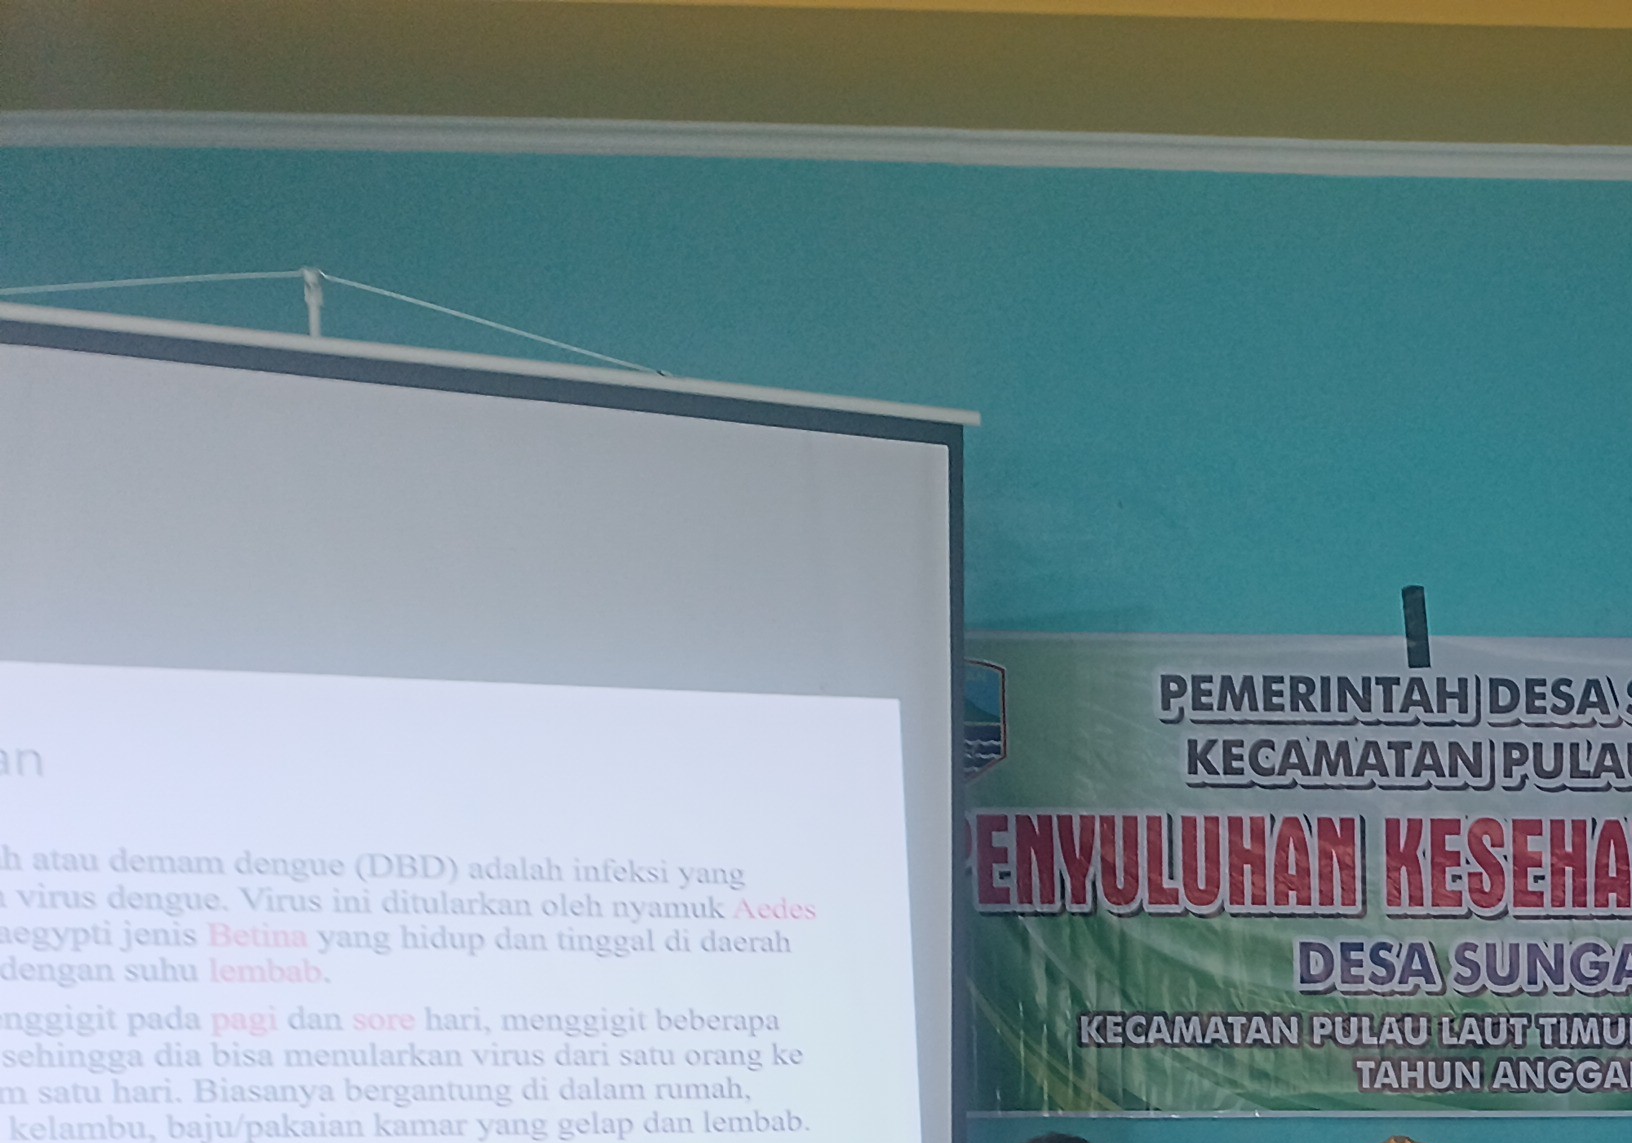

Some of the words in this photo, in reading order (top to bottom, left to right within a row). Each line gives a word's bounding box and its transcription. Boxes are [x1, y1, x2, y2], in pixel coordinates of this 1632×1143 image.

[1160, 674, 1475, 715] PEMERINTAH
[1487, 676, 1605, 716] DESA
[1186, 739, 1482, 779] KECAMATAN
[32, 849, 100, 873] atau
[108, 846, 226, 876] demam
[233, 849, 346, 884] dengue
[354, 853, 459, 884] (DBD)
[468, 855, 565, 882] adalah
[573, 858, 670, 885] infeksi
[677, 866, 746, 892] yang
[15, 882, 98, 911] virus
[106, 883, 229, 918] dengue.
[238, 886, 324, 914] Virus
[332, 887, 373, 915] ini
[380, 888, 533, 917] ditularkan
[540, 892, 604, 918] oleh
[612, 895, 726, 925] nyamuk
[732, 896, 817, 921] Aedes
[0, 919, 114, 953] aegypti
[119, 919, 198, 954] jenis
[206, 921, 309, 949] Betina
[316, 929, 392, 956] yang
[399, 924, 486, 958] hidup
[493, 925, 549, 952] dan
[556, 926, 656, 959] tinggal
[664, 928, 692, 953] di
[700, 929, 792, 954] daerah
[0, 954, 116, 990] dengan
[123, 956, 199, 983] suhu
[208, 956, 332, 984] lembab.
[1299, 940, 1438, 986] DESA
[0, 1004, 118, 1038] nggigit
[126, 1005, 203, 1038] pada
[210, 1004, 279, 1038] pagi
[286, 1004, 345, 1032] dan
[352, 1012, 416, 1032] sore
[424, 1005, 492, 1036] hari,
[501, 1007, 647, 1039] menggigit
[655, 1007, 781, 1038] beberapa
[1079, 1014, 1299, 1047] KECAMATAN
[1311, 1014, 1428, 1047] PULAU
[1440, 1015, 1530, 1047] LAUT
[1, 1041, 145, 1075] sehingga
[153, 1041, 203, 1068] dia
[210, 1041, 275, 1068] bisa
[284, 1041, 464, 1068] menularkan
[471, 1042, 546, 1068] virus
[553, 1041, 611, 1067] dari
[618, 1047, 676, 1067] satu
[684, 1049, 764, 1073] orang
[771, 1042, 804, 1066] ke
[1356, 1059, 1482, 1091] TAHUN
[37, 1082, 103, 1105] satu
[111, 1077, 183, 1105] hari.
[193, 1076, 336, 1110] Biasanya
[343, 1076, 514, 1110] bergantung
[521, 1075, 550, 1102] di
[558, 1076, 646, 1102] dalam
[655, 1075, 752, 1102] rumah,
[8, 1113, 157, 1143] kelambu,
[373, 1111, 469, 1138] kamar
[476, 1117, 549, 1143] yang
[557, 1112, 635, 1142] gelap
[642, 1110, 695, 1135] dan
[703, 1108, 810, 1134] lembab.
